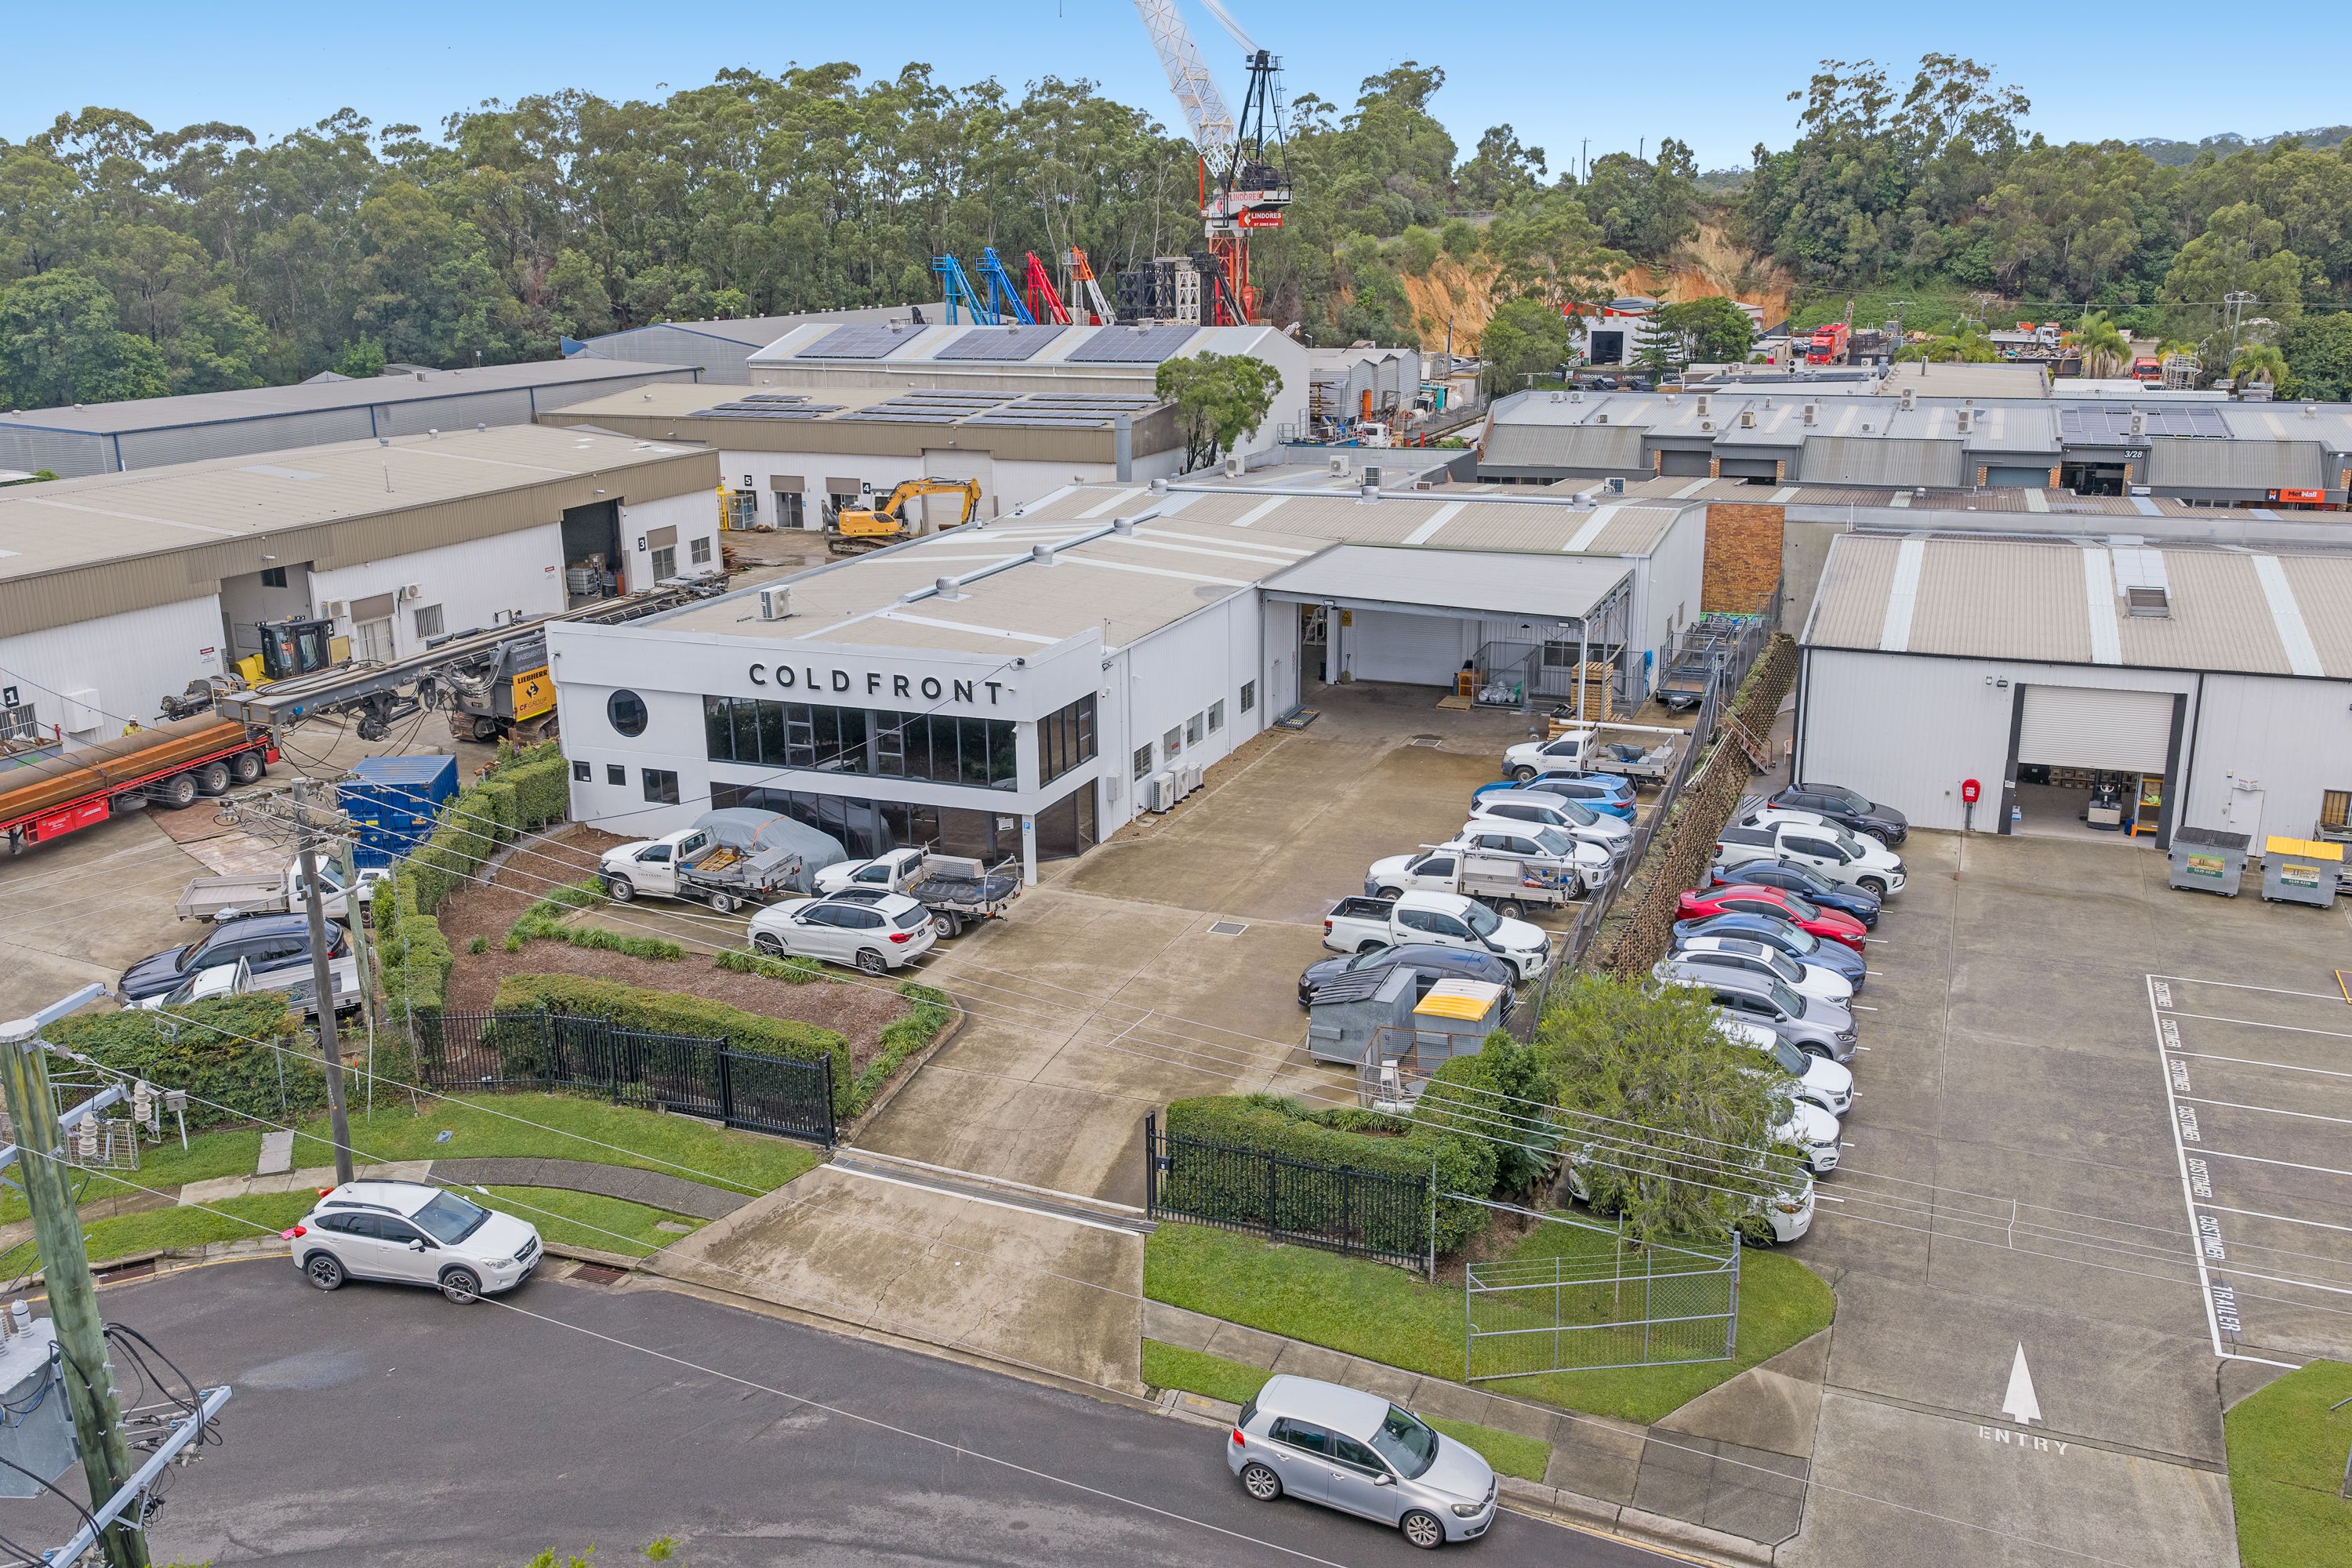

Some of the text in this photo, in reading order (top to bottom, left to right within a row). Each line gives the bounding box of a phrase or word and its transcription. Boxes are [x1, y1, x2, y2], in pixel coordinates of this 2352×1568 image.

[1229, 192, 1261, 201] LINDORES
[863, 484, 869, 492] 4
[639, 539, 645, 549] 3
[327, 623, 334, 634] 2
[517, 670, 548, 684] LIEBHERR
[749, 663, 1002, 705] COLD FRONT
[6, 690, 18, 705] 1
[528, 697, 547, 709] GROUP
[2154, 982, 2172, 1007] CUSTOMER
[2161, 1019, 2181, 1047] CUSTOMER
[2170, 1059, 2190, 1091] CUSTOMER
[2178, 1105, 2201, 1142] CUSTOMER
[2189, 1158, 2212, 1198] CUSTOMER
[2199, 1215, 2225, 1260] CUSTOMER
[2212, 1286, 2241, 1331] TRAILER
[1979, 1425, 2068, 1456] ENTRY
